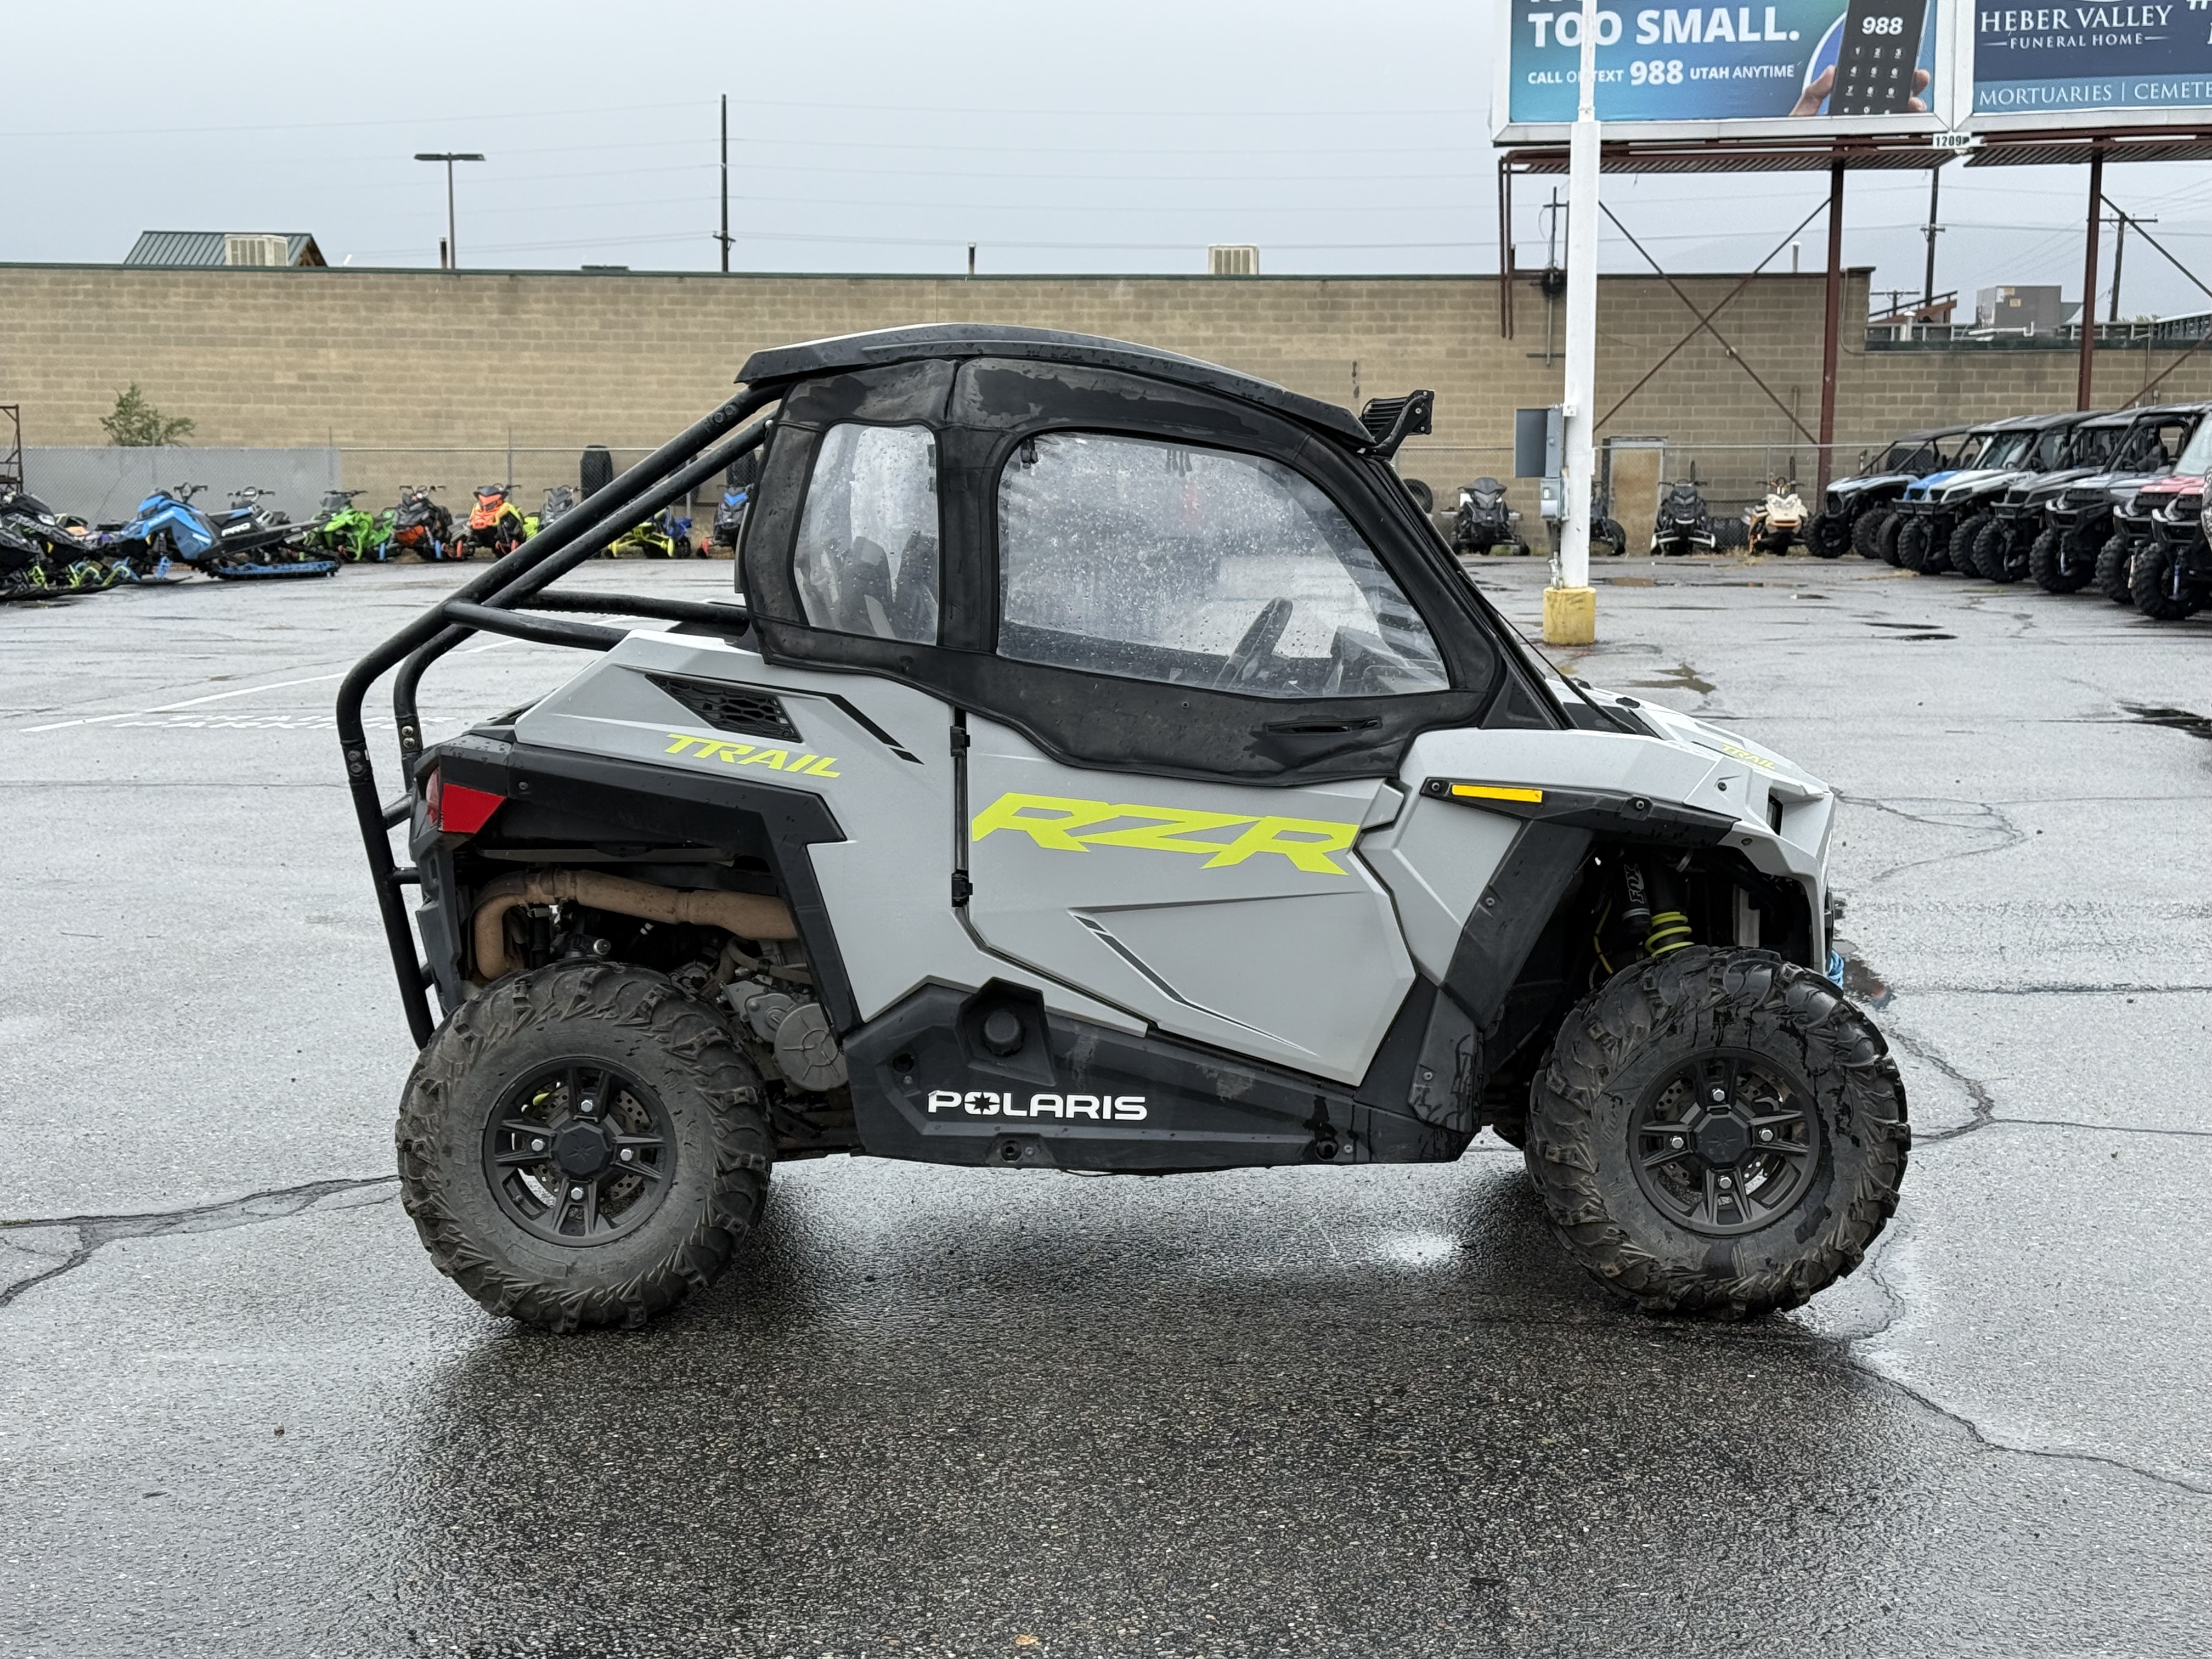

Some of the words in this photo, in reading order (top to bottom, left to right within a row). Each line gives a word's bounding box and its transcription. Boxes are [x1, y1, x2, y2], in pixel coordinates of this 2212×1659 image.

[1528, 11, 1623, 47] TOO
[1636, 7, 1800, 44] SMALL.
[1861, 16, 1904, 35] 988
[1979, 8, 2071, 32] HEBER
[2075, 4, 2174, 29] VALLEY
[2010, 35, 2086, 49] FUNERAL
[2092, 33, 2143, 46] HOME
[1528, 71, 1562, 84] CALL
[1566, 71, 1581, 83] O
[1630, 60, 1684, 86] 988
[1690, 66, 1729, 81] UTAH
[1732, 64, 1795, 80] ANYTIME
[1979, 84, 2112, 106] MORTUARIES
[664, 733, 840, 778] TRAIL
[1721, 743, 1776, 770] TRAIL
[972, 792, 1360, 876] RZR
[1624, 863, 1645, 904] FOX
[928, 1090, 1148, 1121] POLARIS
